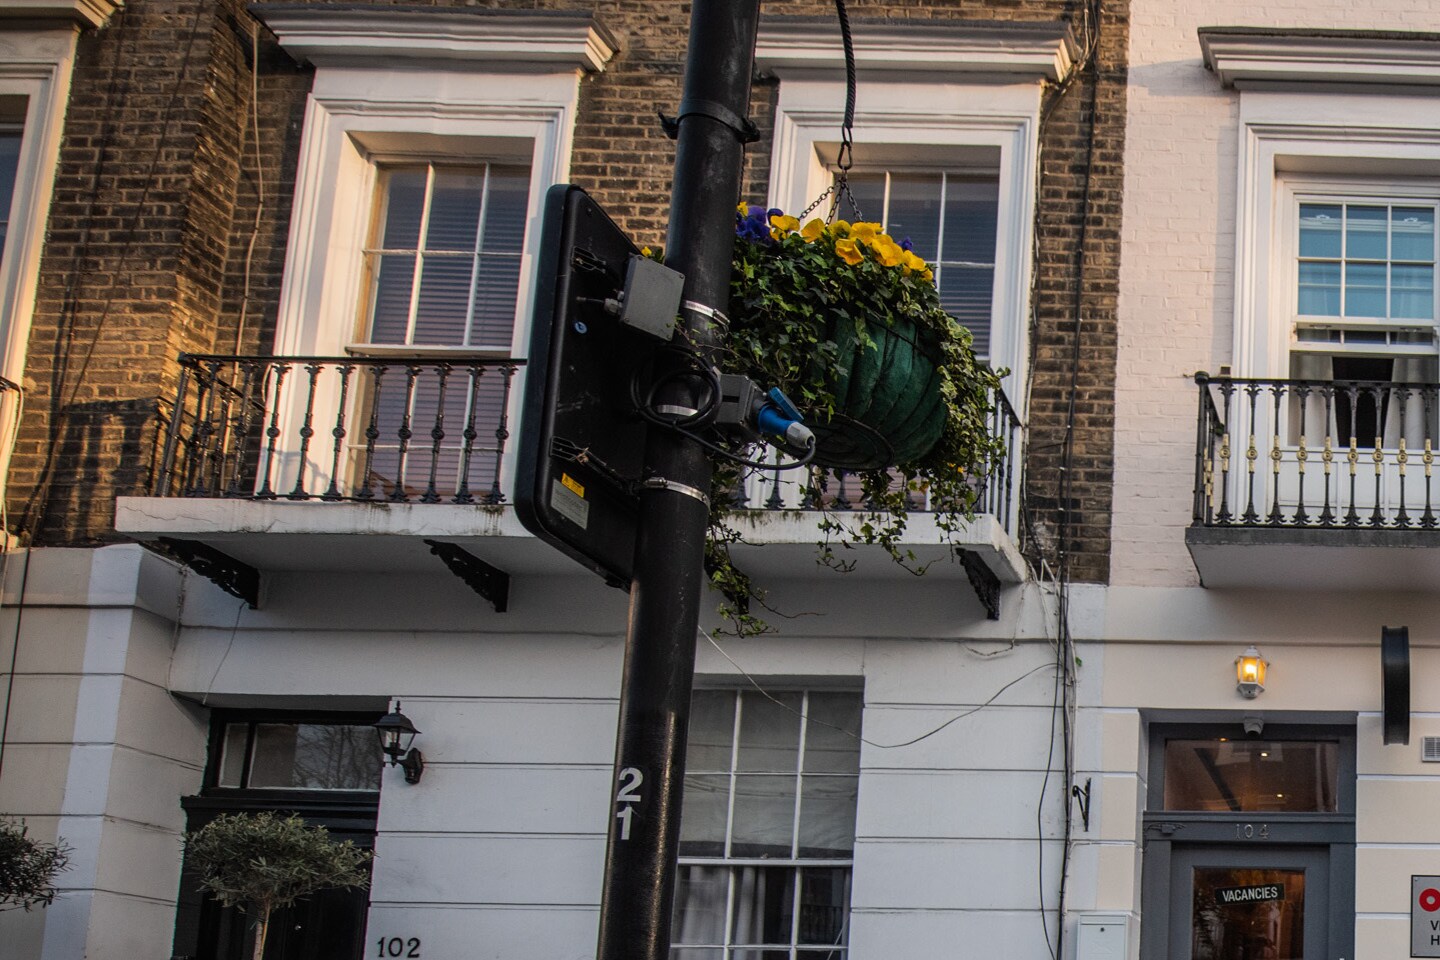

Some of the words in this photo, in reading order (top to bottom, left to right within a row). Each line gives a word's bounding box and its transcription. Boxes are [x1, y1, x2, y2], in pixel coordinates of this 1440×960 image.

[1235, 823, 1269, 839] 104
[1222, 886, 1279, 902] VACANCIES
[377, 936, 421, 958] 102
